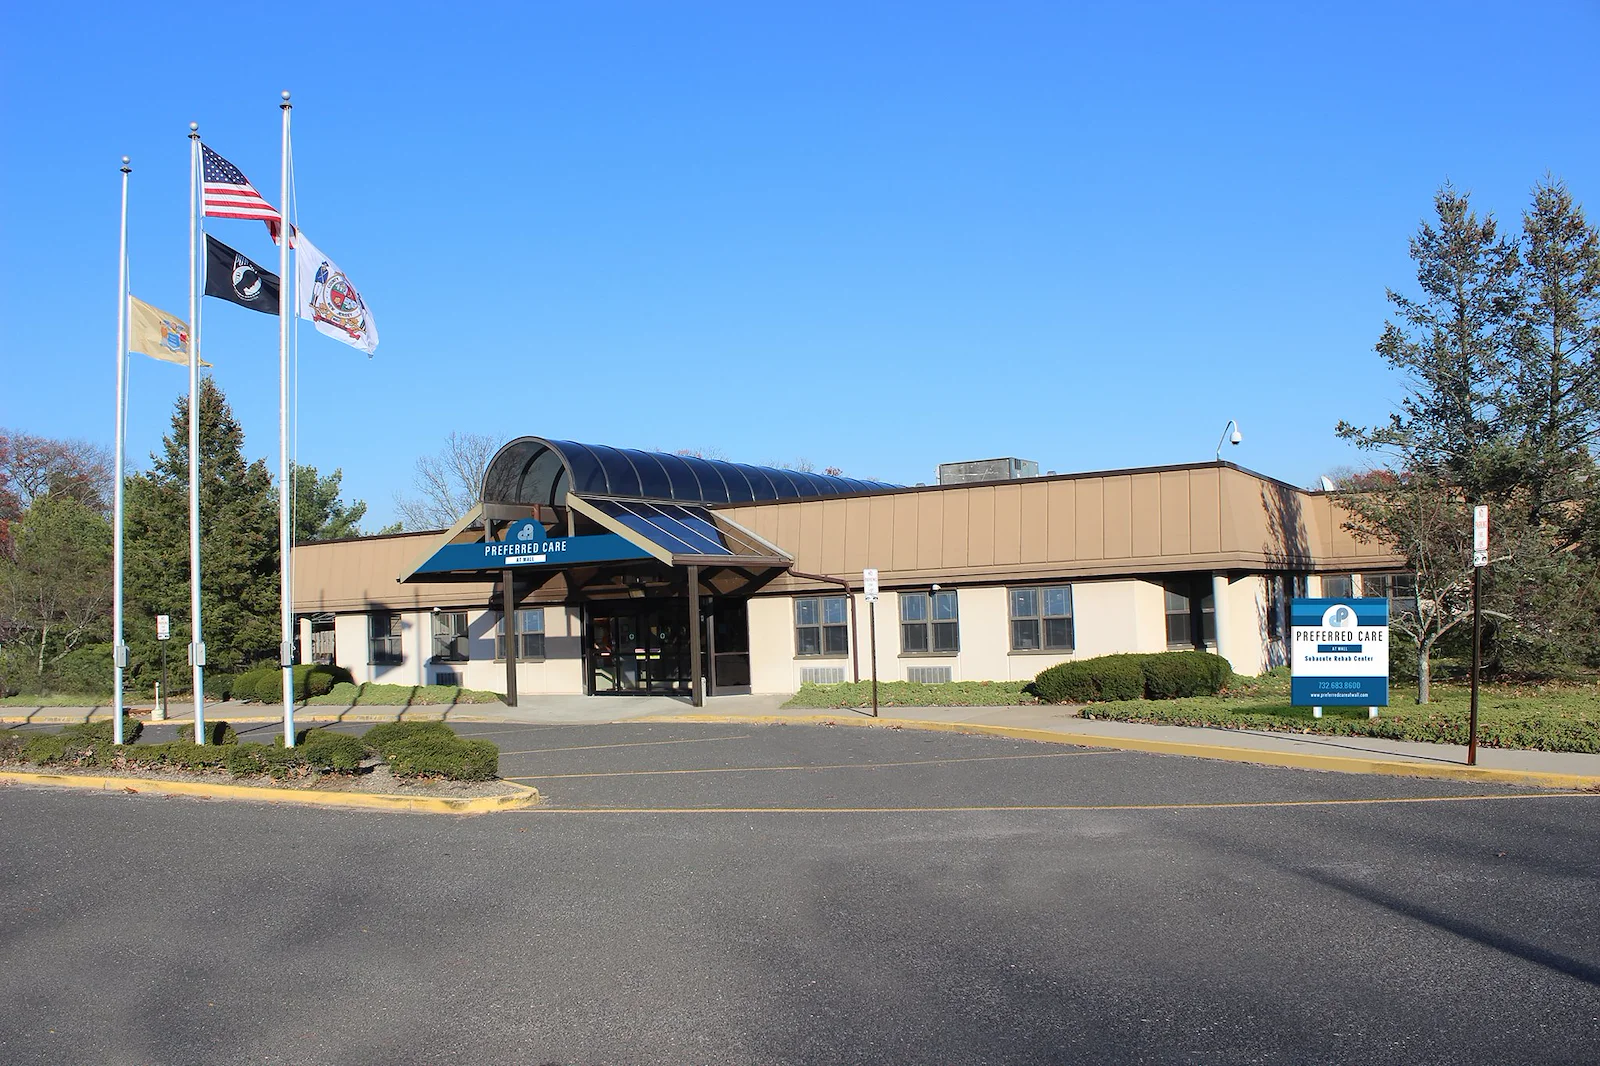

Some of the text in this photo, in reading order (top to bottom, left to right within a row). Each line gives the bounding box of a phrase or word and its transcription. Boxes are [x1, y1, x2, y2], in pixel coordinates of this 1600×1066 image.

[484, 540, 567, 556] PREFERRED CARE
[1296, 630, 1383, 642] PREFERRED CARE
[1318, 681, 1361, 690] 732.683.8600
